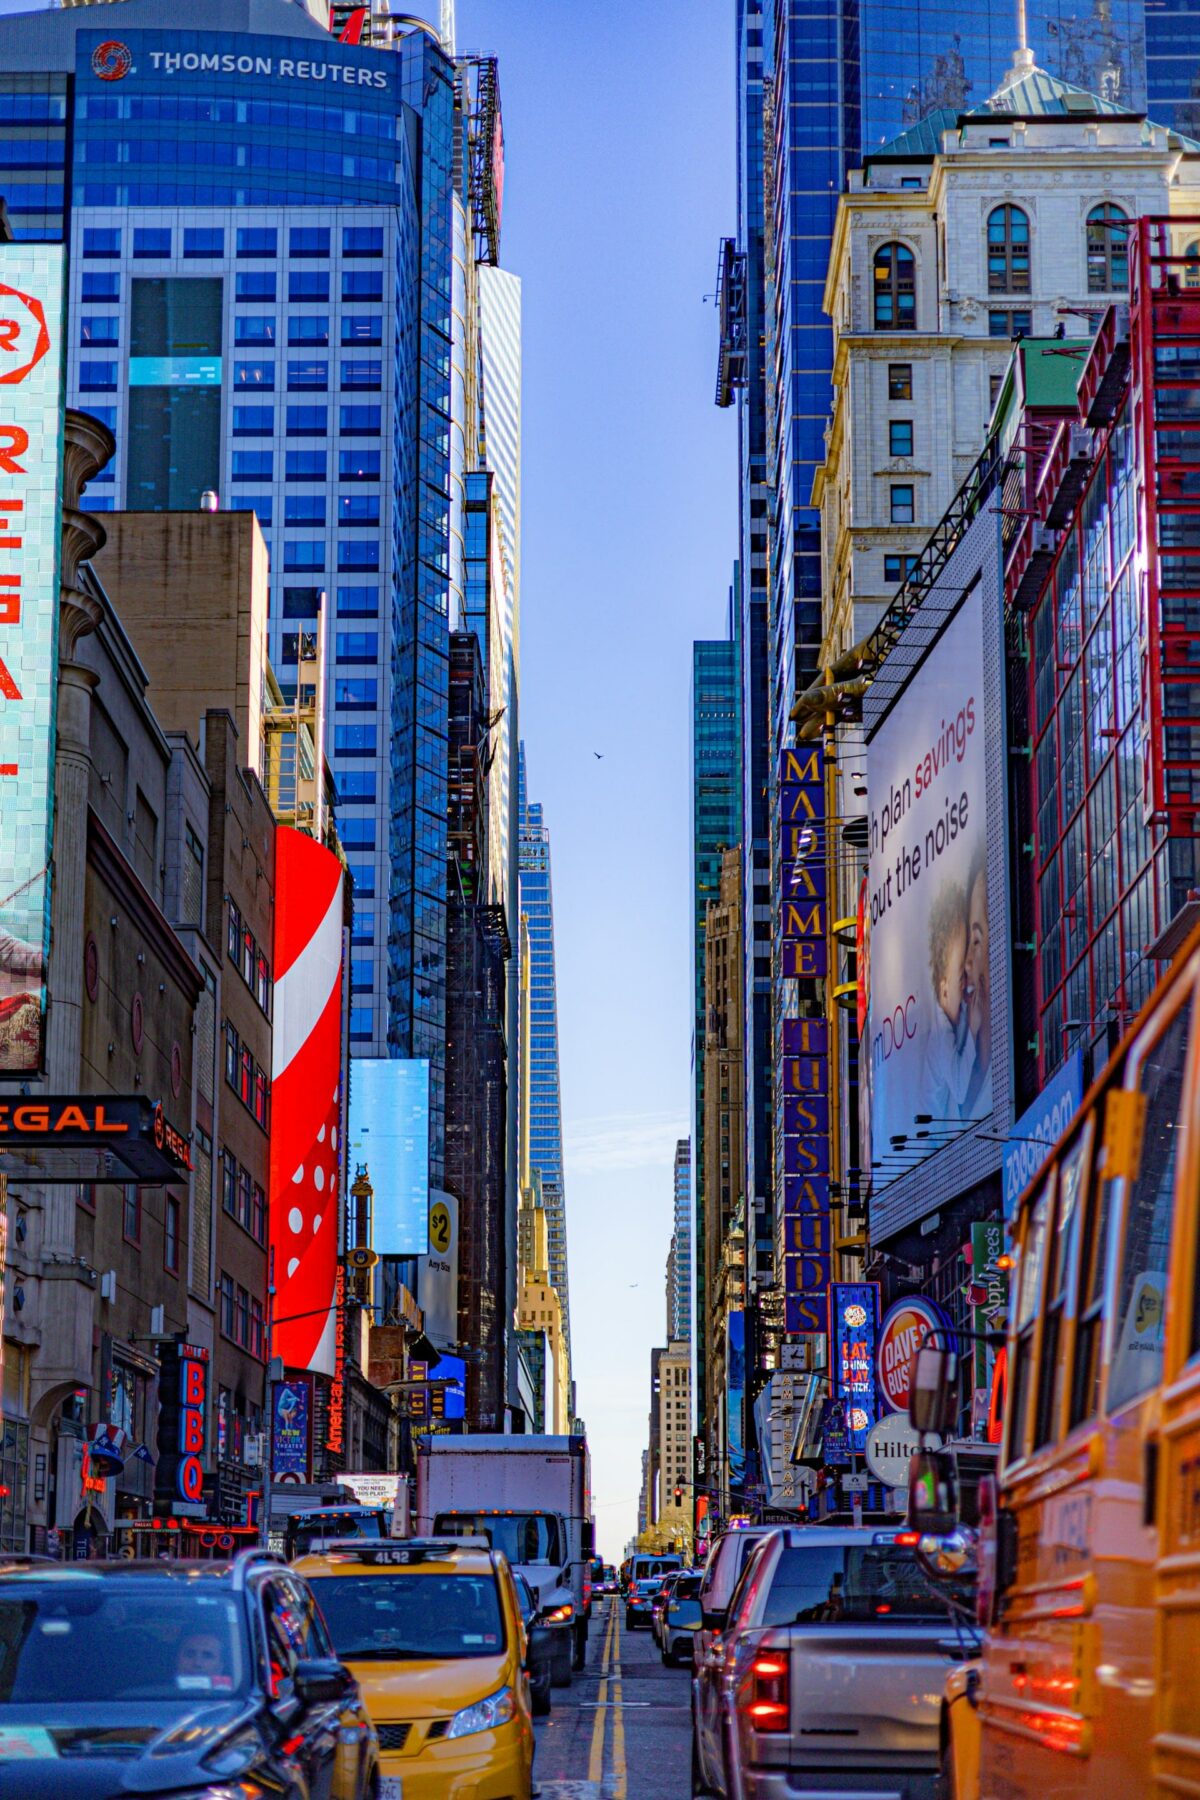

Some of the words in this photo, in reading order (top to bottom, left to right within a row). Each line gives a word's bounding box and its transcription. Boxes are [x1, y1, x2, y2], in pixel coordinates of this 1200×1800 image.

[150, 51, 271, 75] THOMSON
[279, 59, 388, 88] REUTERS
[881, 777, 912, 853] plan
[914, 696, 976, 799] savings
[784, 751, 824, 975] MADAME
[895, 845, 921, 898] the
[924, 791, 969, 869] noise
[0, 1105, 129, 1132] GAL
[791, 1021, 824, 1330] TUSSAUDS
[432, 1213, 448, 1243] $2
[842, 1342, 871, 1360] EAT.
[885, 1324, 919, 1373] DAVE
[180, 1360, 206, 1502] BBQ
[874, 1442, 934, 1458] Hilton
[375, 1551, 410, 1564] 4L92
